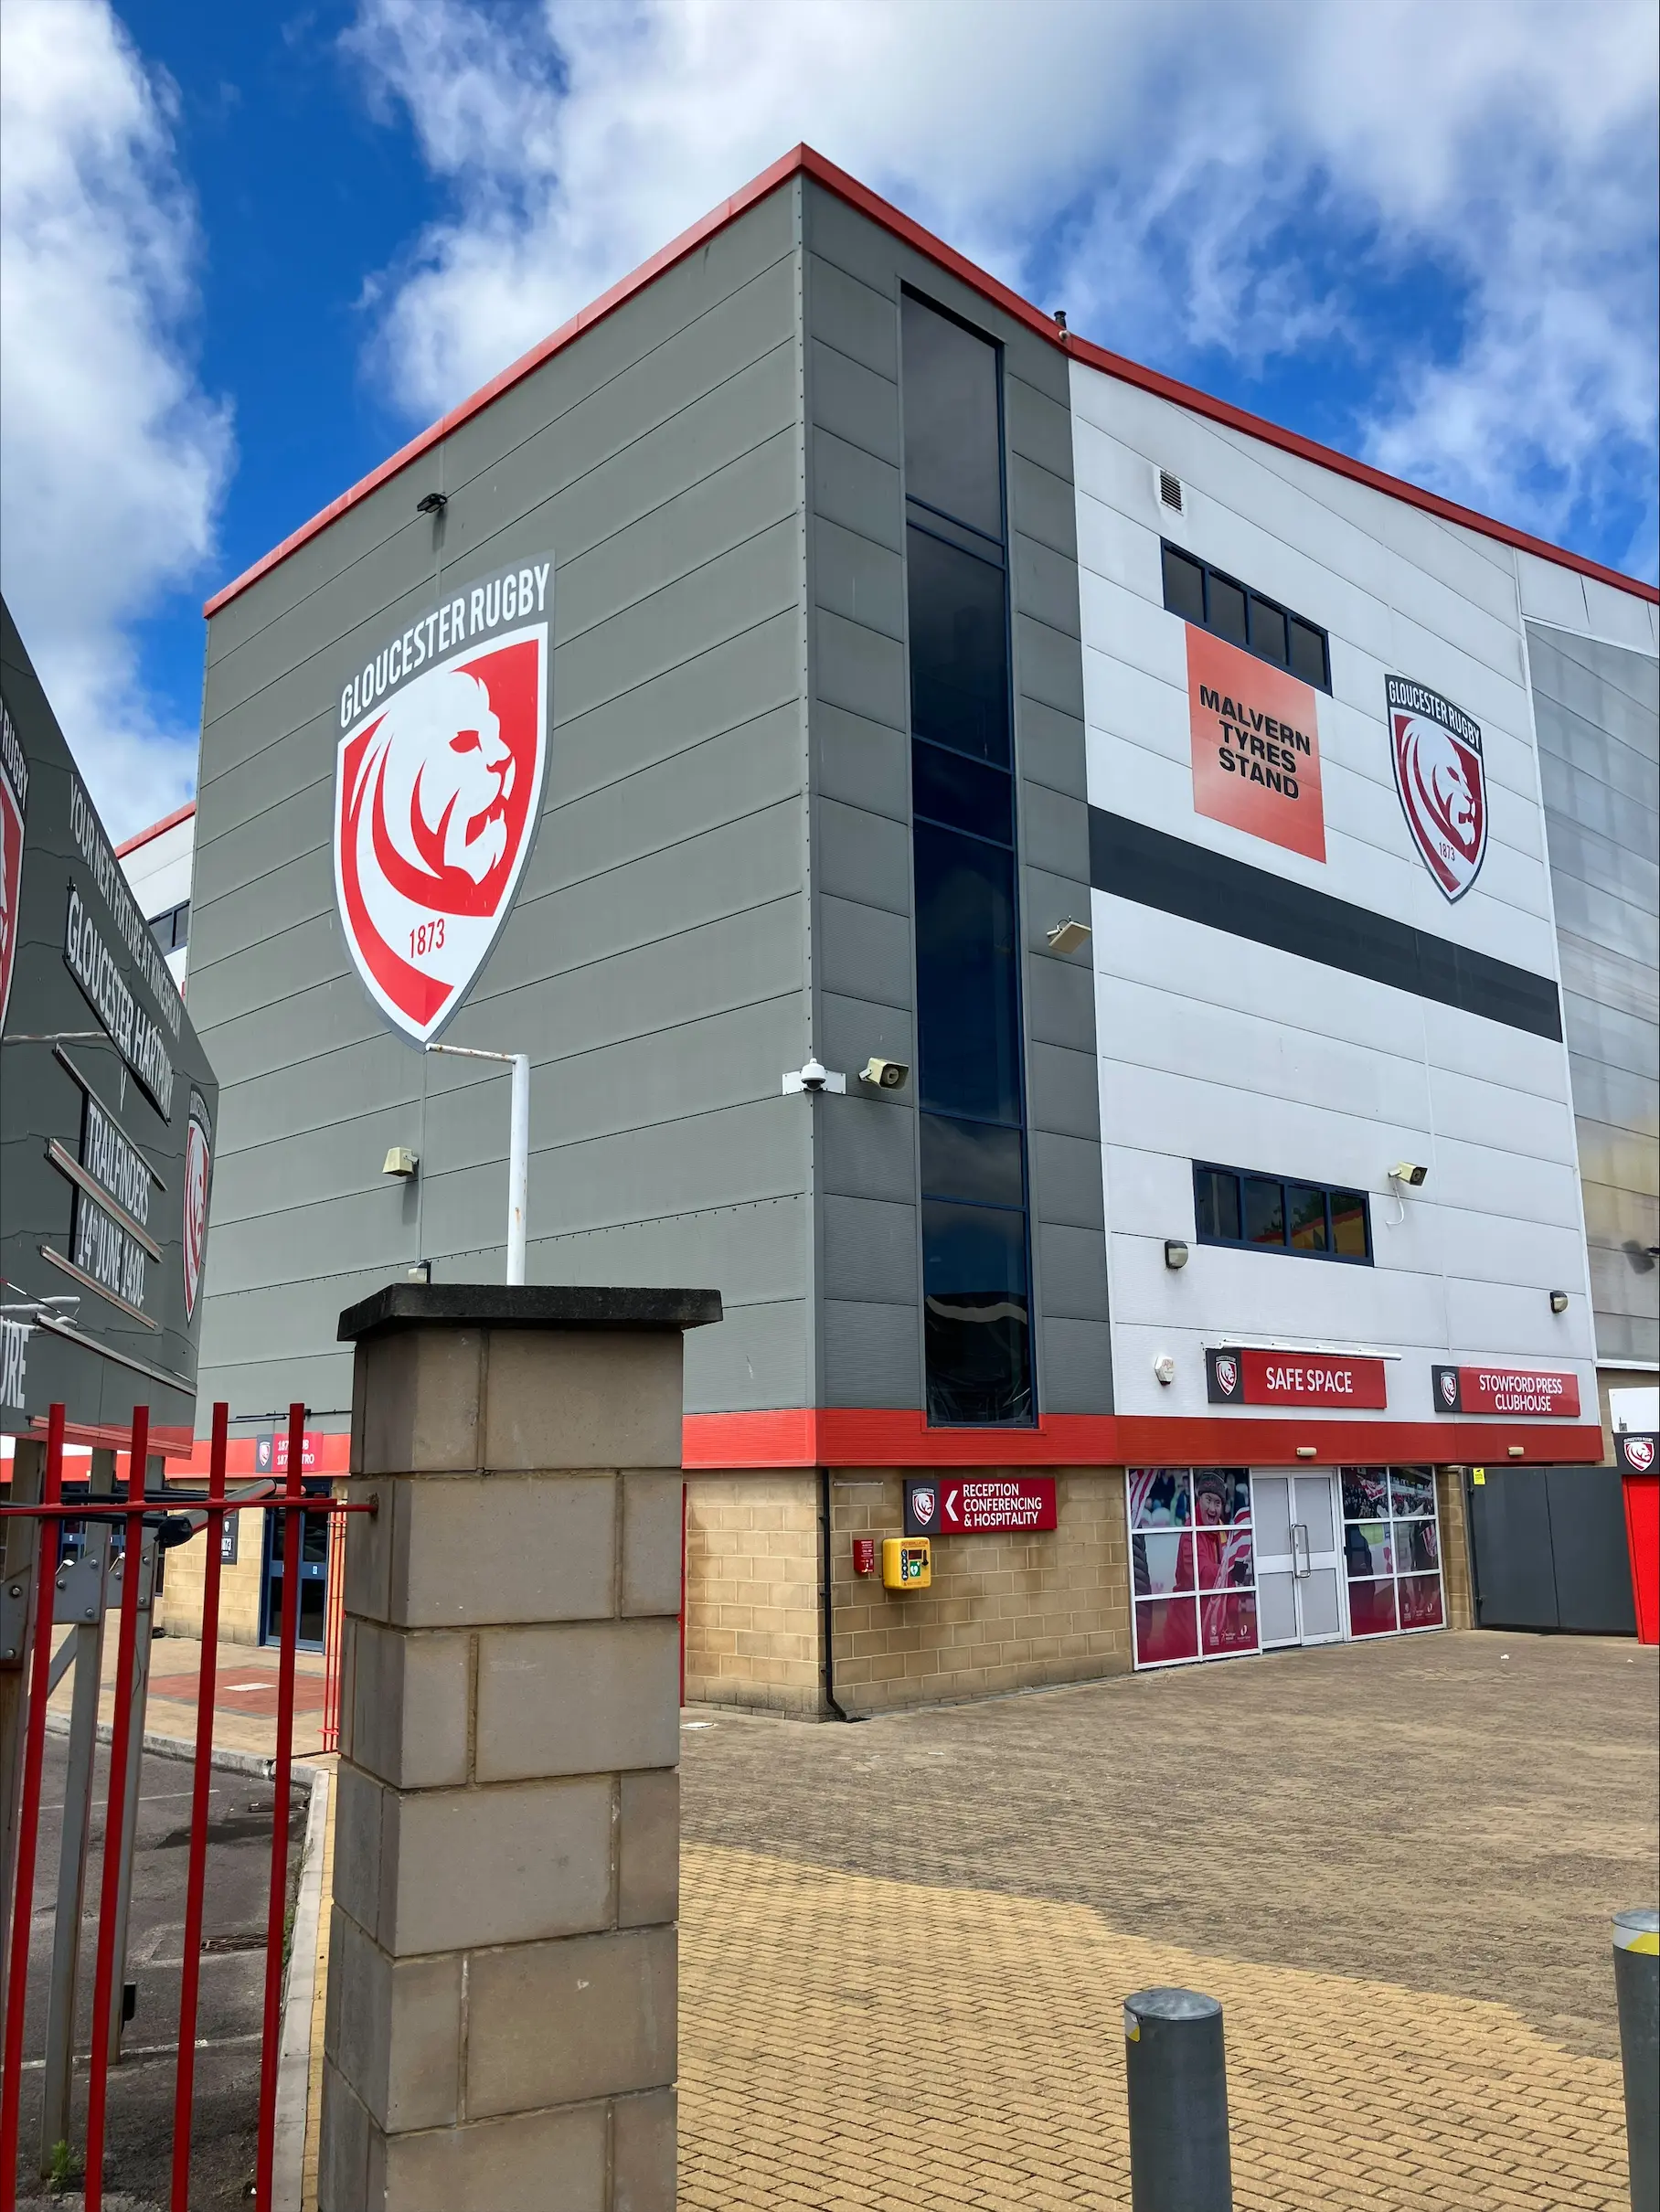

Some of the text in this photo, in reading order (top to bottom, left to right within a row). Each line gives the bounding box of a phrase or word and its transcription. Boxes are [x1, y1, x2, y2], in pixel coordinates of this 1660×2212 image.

[341, 563, 550, 728] GLOUCESTER RUGBY
[1199, 684, 1311, 757] MALVERN
[1389, 680, 1480, 750] GLOUCESTER RUGBY
[2, 708, 29, 811] RUGBY
[1218, 719, 1297, 774] TYRES
[1218, 747, 1299, 800] STAND
[1438, 841, 1456, 862] 1873
[69, 772, 95, 872] YOUR
[93, 830, 116, 911] NEXT
[113, 875, 144, 968] FIXTURE
[140, 933, 154, 984] AT
[409, 918, 446, 959] 1873
[67, 889, 135, 1058] GLOUCESTER
[87, 1101, 151, 1227] TRAILFINDERS
[95, 1215, 123, 1293] JUNE
[1266, 1367, 1354, 1394] SAFE SPACE
[1479, 1374, 1562, 1394] STOWFORD PRESS
[1495, 1394, 1552, 1411] CLUBHOUSE
[276, 1454, 290, 1466] 187
[277, 1440, 291, 1452] 187
[963, 1484, 1019, 1497] RECEPTION
[963, 1497, 1042, 1513] CONFERENCING
[963, 1511, 1039, 1527] & HOSPITALITY
